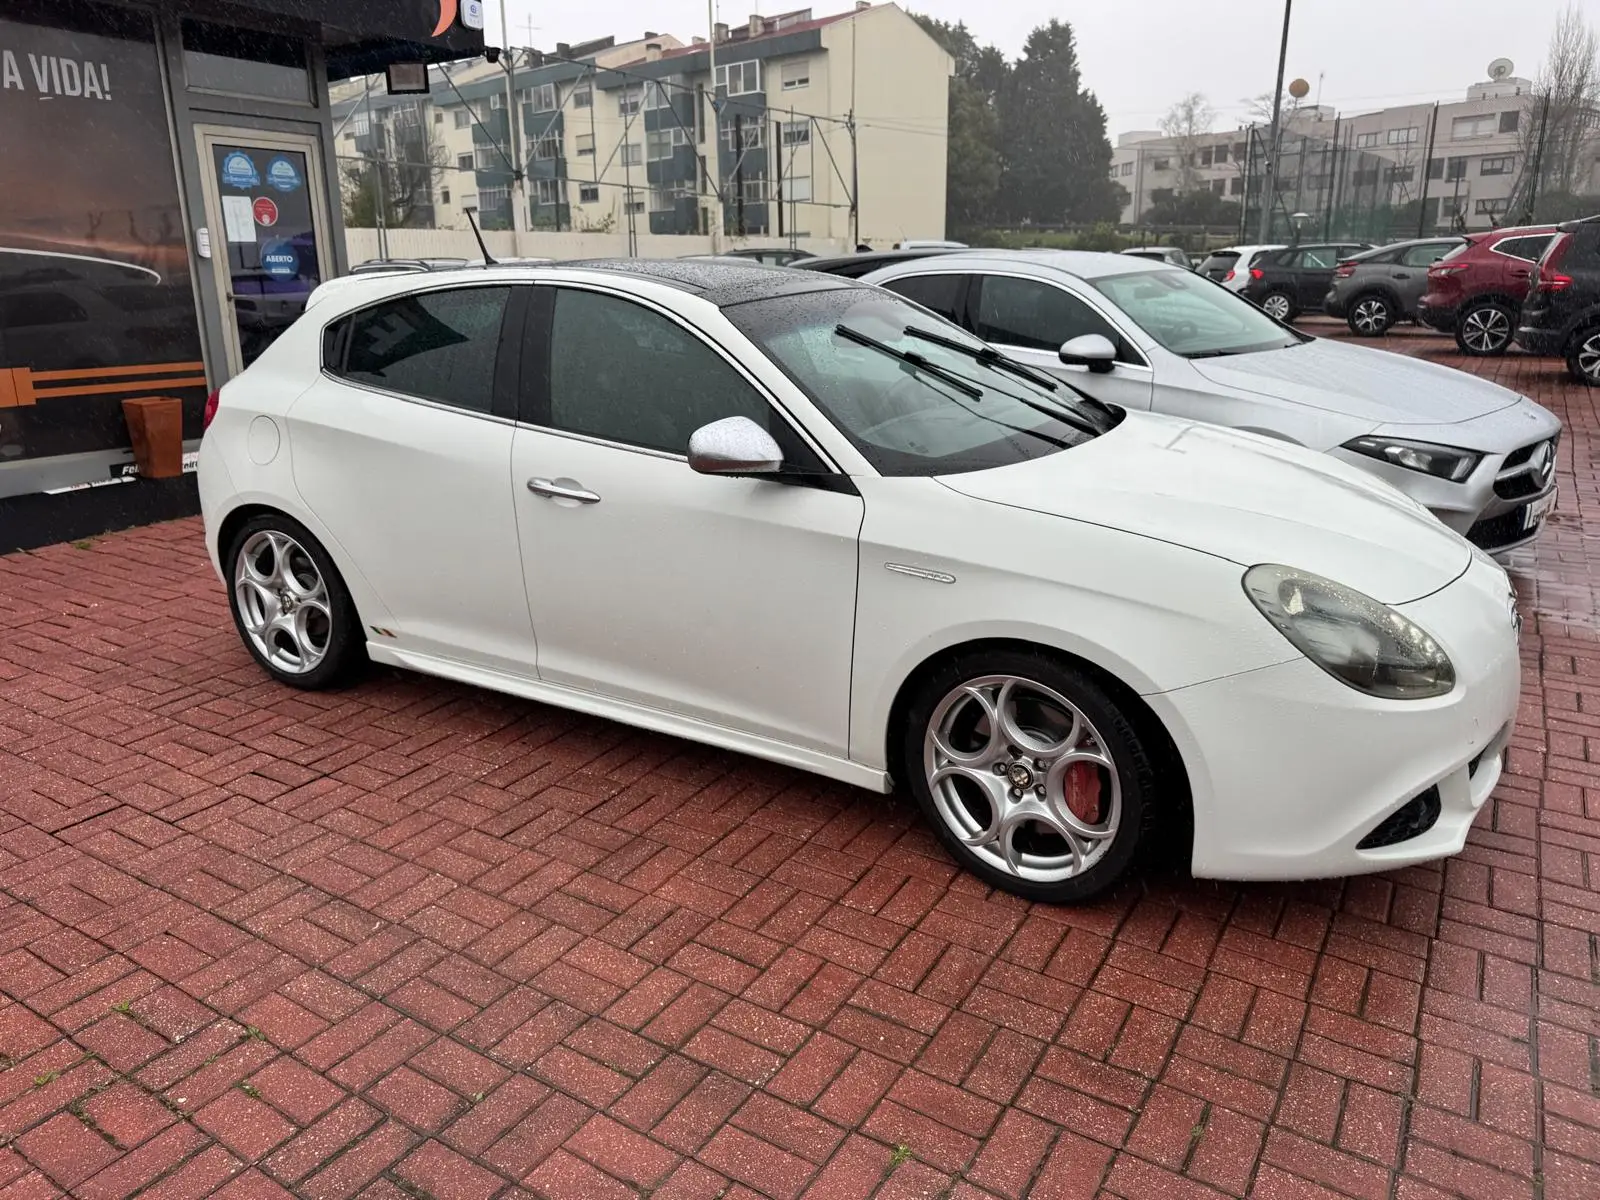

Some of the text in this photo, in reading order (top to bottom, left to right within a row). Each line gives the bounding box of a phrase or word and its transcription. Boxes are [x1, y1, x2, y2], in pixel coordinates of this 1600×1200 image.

[3, 50, 112, 101] A VIDA!
[266, 255, 293, 263] ABERTO
